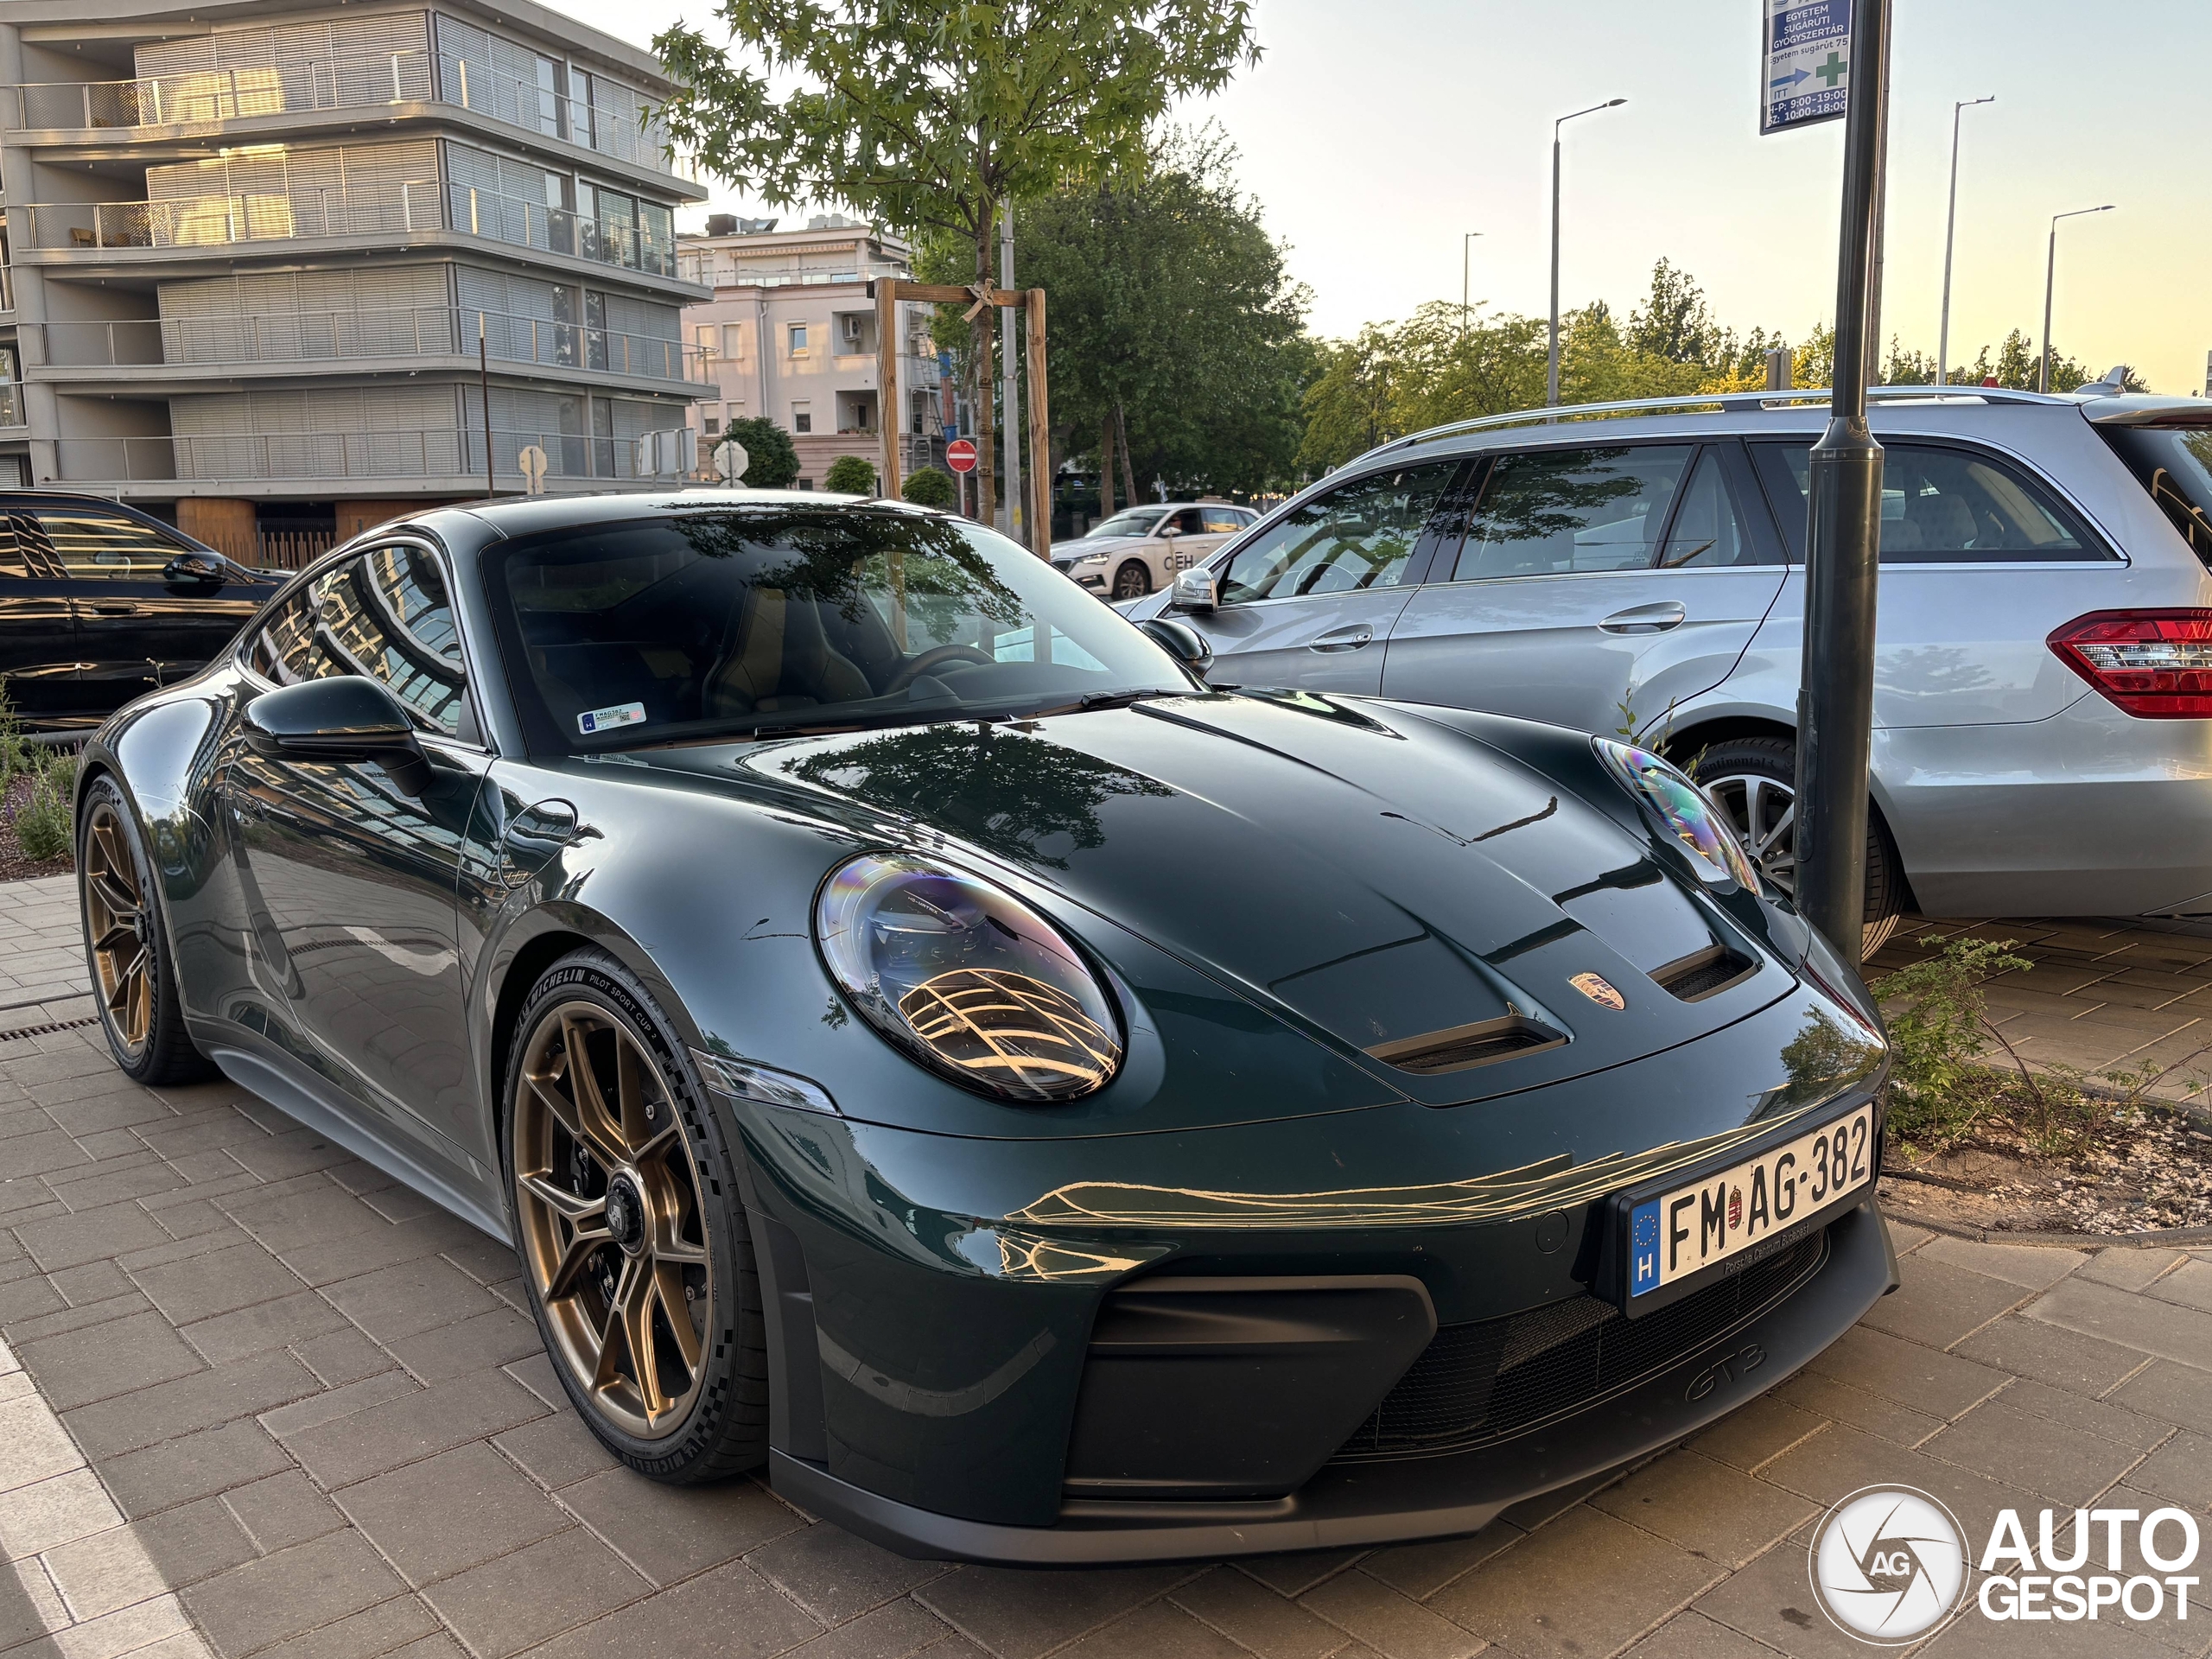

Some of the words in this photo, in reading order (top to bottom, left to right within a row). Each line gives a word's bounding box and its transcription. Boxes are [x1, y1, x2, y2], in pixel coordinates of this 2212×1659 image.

[1785, 4, 1829, 22] EGYETEM
[1773, 23, 1844, 48] GYÓGYSZERTÁR
[1783, 16, 1830, 35] SUGÁRÚTI
[1801, 41, 1834, 54] sugárút
[1835, 37, 1848, 47] 75
[1774, 88, 1788, 99] ITT
[1790, 90, 1847, 109] 9:00-19:00
[1784, 101, 1847, 121] 10:00-18:00
[1698, 757, 1766, 776] Continental
[531, 969, 586, 1006] MICHELIN
[589, 974, 610, 990] PILOT
[610, 987, 636, 1011] SPORT
[635, 1013, 652, 1032] CUP
[1669, 1181, 1726, 1272] FM
[1725, 1254, 1752, 1274] Porsche
[1753, 1241, 1781, 1260] Centrum
[1781, 1223, 1809, 1246] Budapest
[1638, 1253, 1652, 1282] H
[1685, 1344, 1767, 1402] GT3
[623, 1452, 685, 1473] MICHELIN
